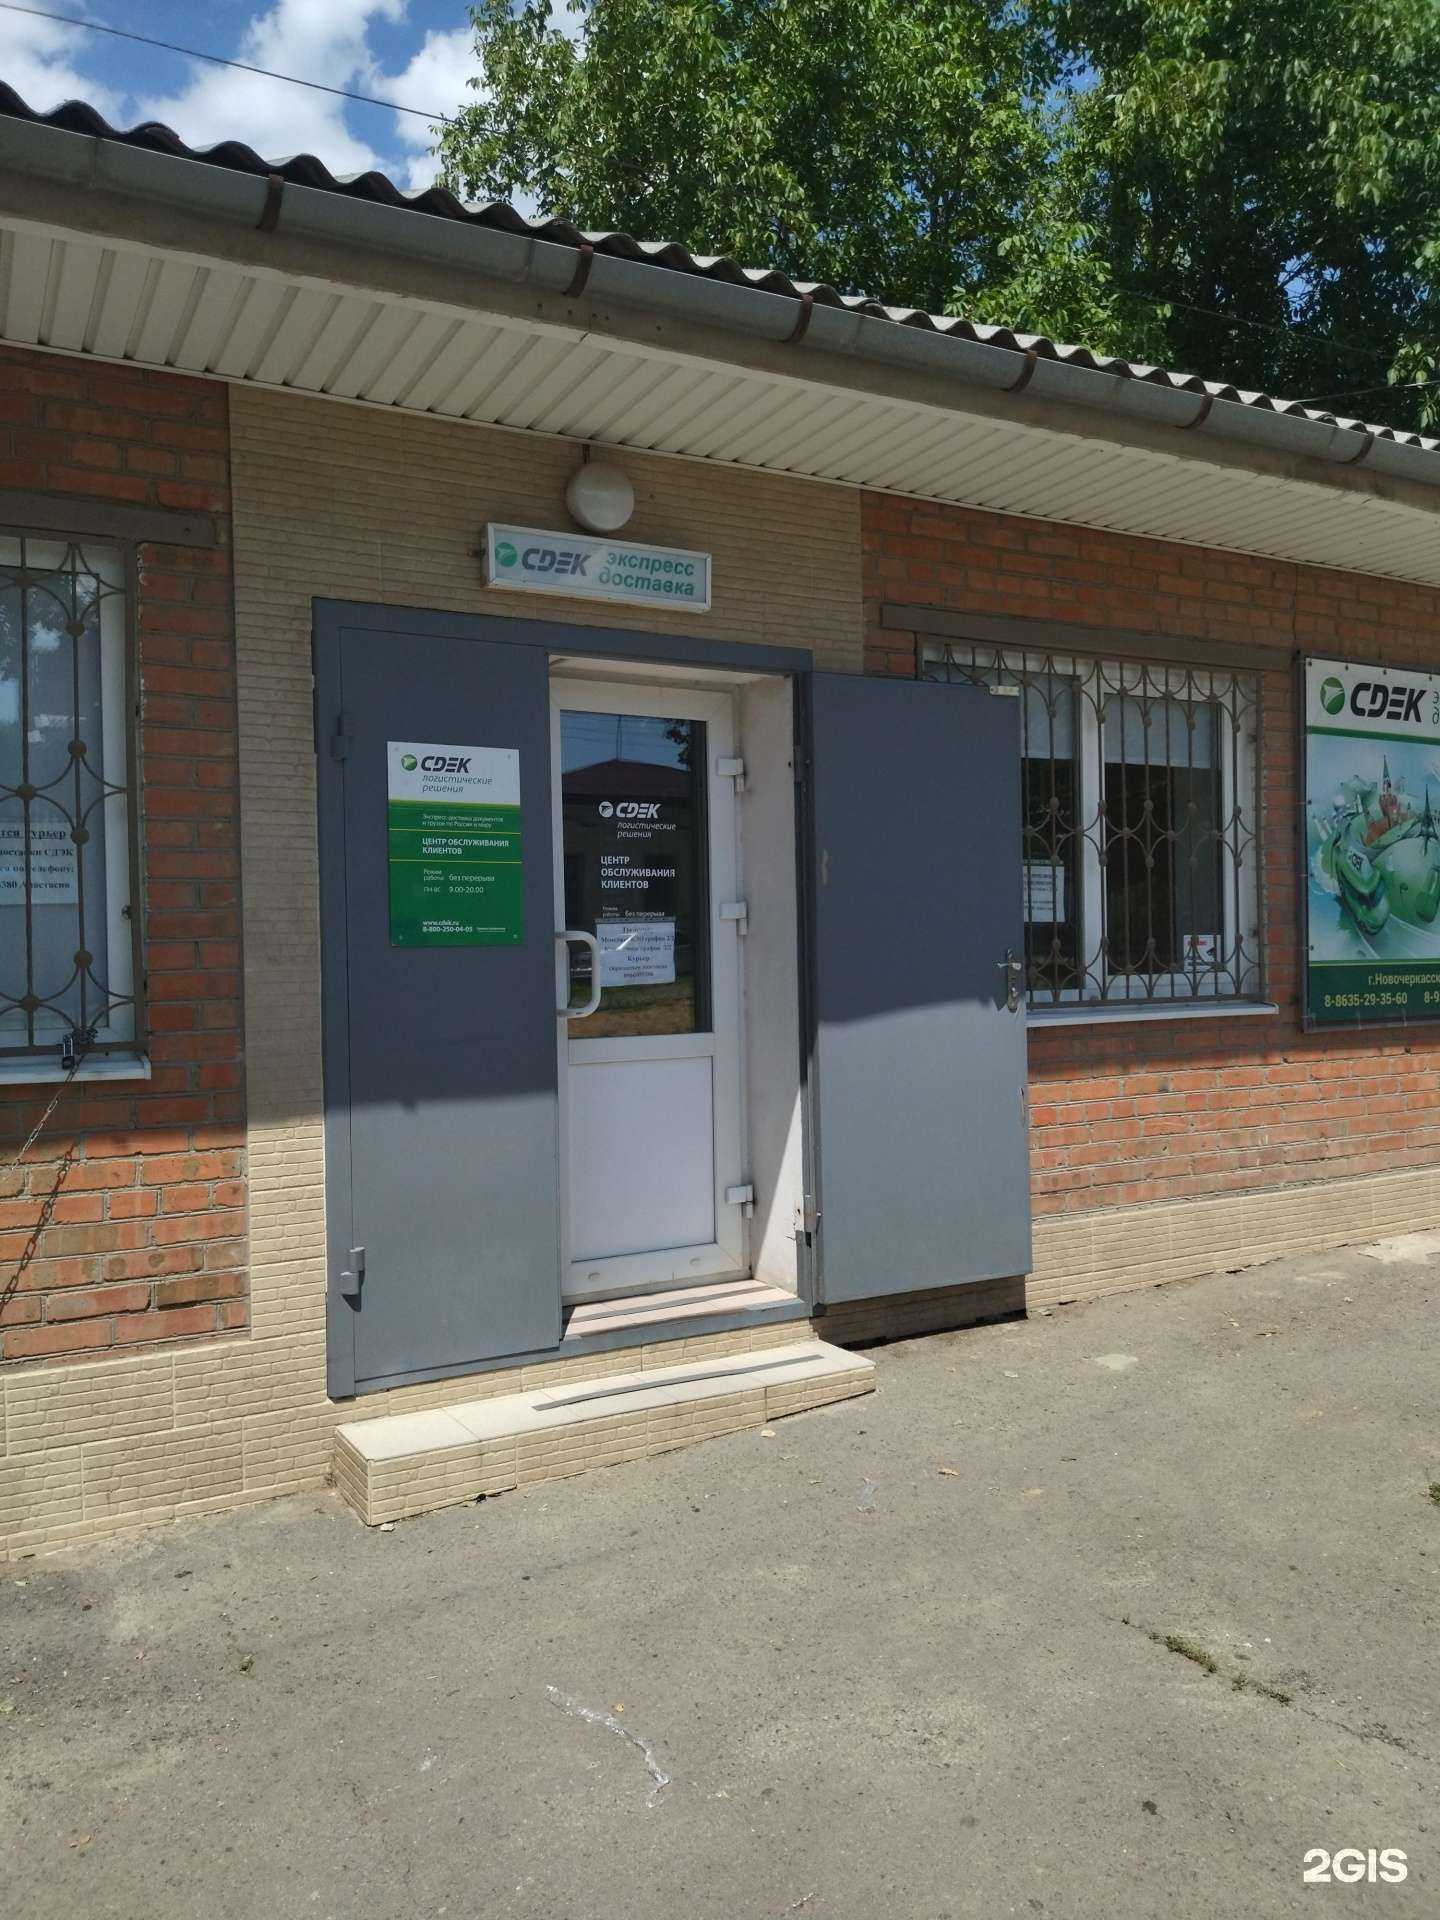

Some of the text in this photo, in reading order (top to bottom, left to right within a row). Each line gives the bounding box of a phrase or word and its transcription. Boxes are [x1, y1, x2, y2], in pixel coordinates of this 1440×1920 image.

[521, 548, 592, 577] CDEK
[607, 552, 695, 576] экспресс
[598, 567, 695, 596] доставка
[1350, 682, 1427, 723] CDEK
[421, 756, 472, 773] CDEK
[422, 774, 493, 786] логистические
[422, 784, 464, 793] решения
[616, 802, 661, 818] CDEK
[617, 822, 677, 831] логистические
[617, 831, 652, 839] решения
[422, 838, 509, 847] ЦЕНТР ОБСЛУЖИВАНИЯ
[422, 847, 462, 855] КЛИЕНТОВ
[601, 856, 630, 866] ЦЕНТР
[601, 868, 676, 878] ОБСЛУЖИВАНИЯ
[601, 880, 649, 889] КЛИЕНТОВ
[1324, 992, 1408, 1008] 8-8635-29-35-60
